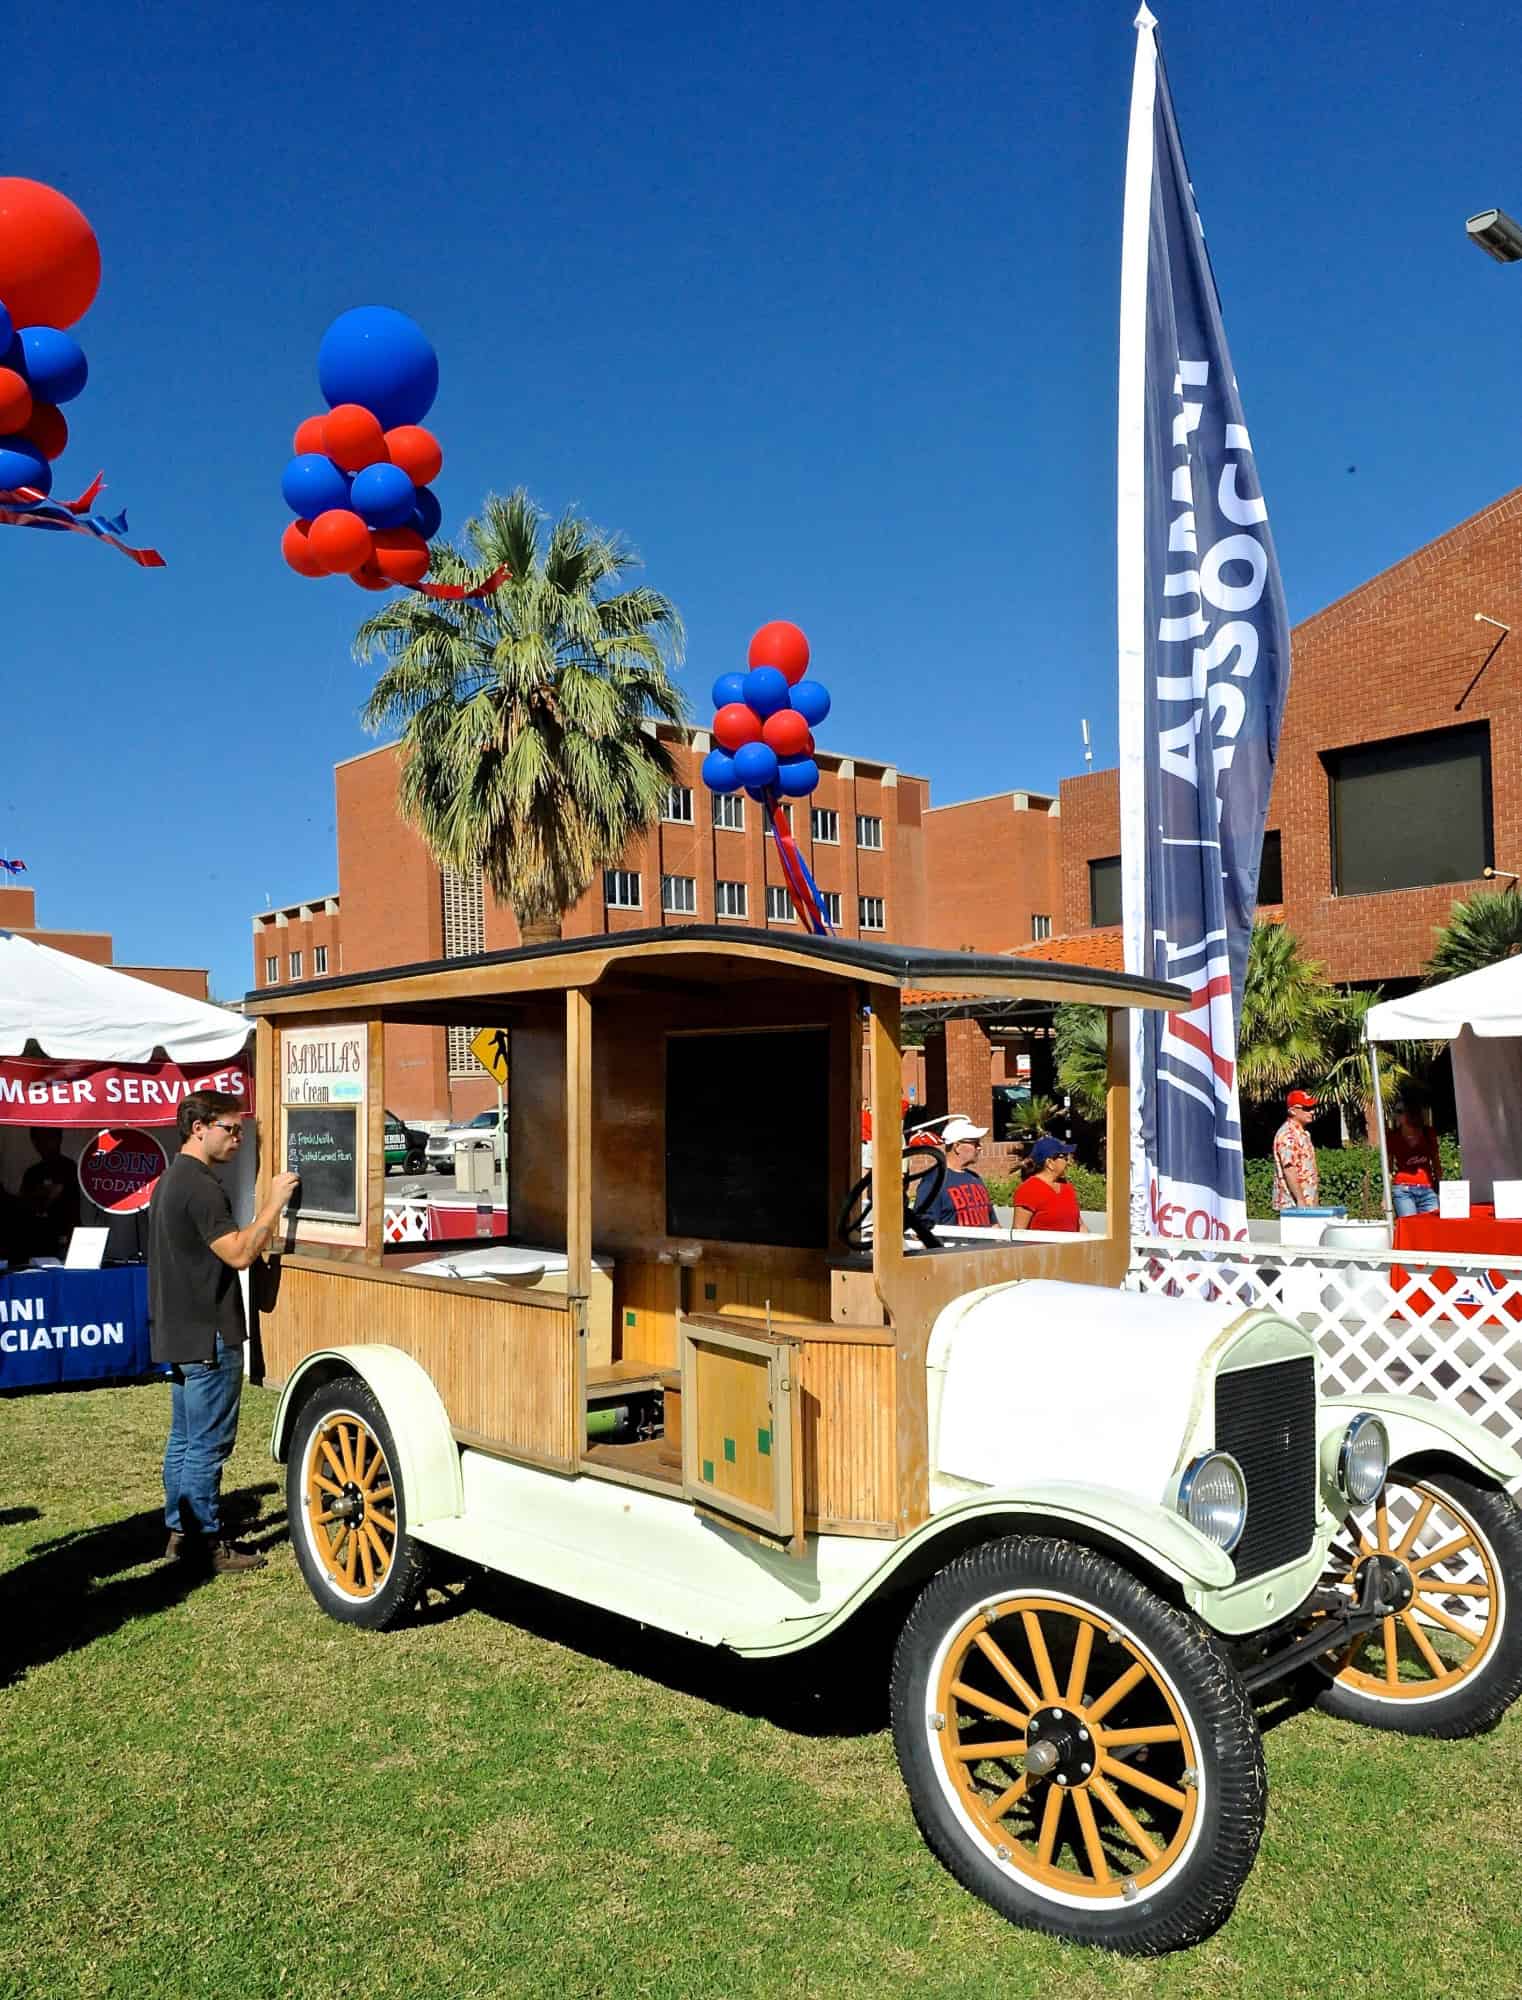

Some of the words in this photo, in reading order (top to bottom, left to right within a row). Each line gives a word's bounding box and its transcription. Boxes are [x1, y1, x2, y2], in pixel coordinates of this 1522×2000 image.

[287, 1041, 361, 1074] ISABELLA'S
[303, 1078, 329, 1104] Cream
[88, 1149, 158, 1175] JOIN
[0, 1322, 124, 1352] CIATION
